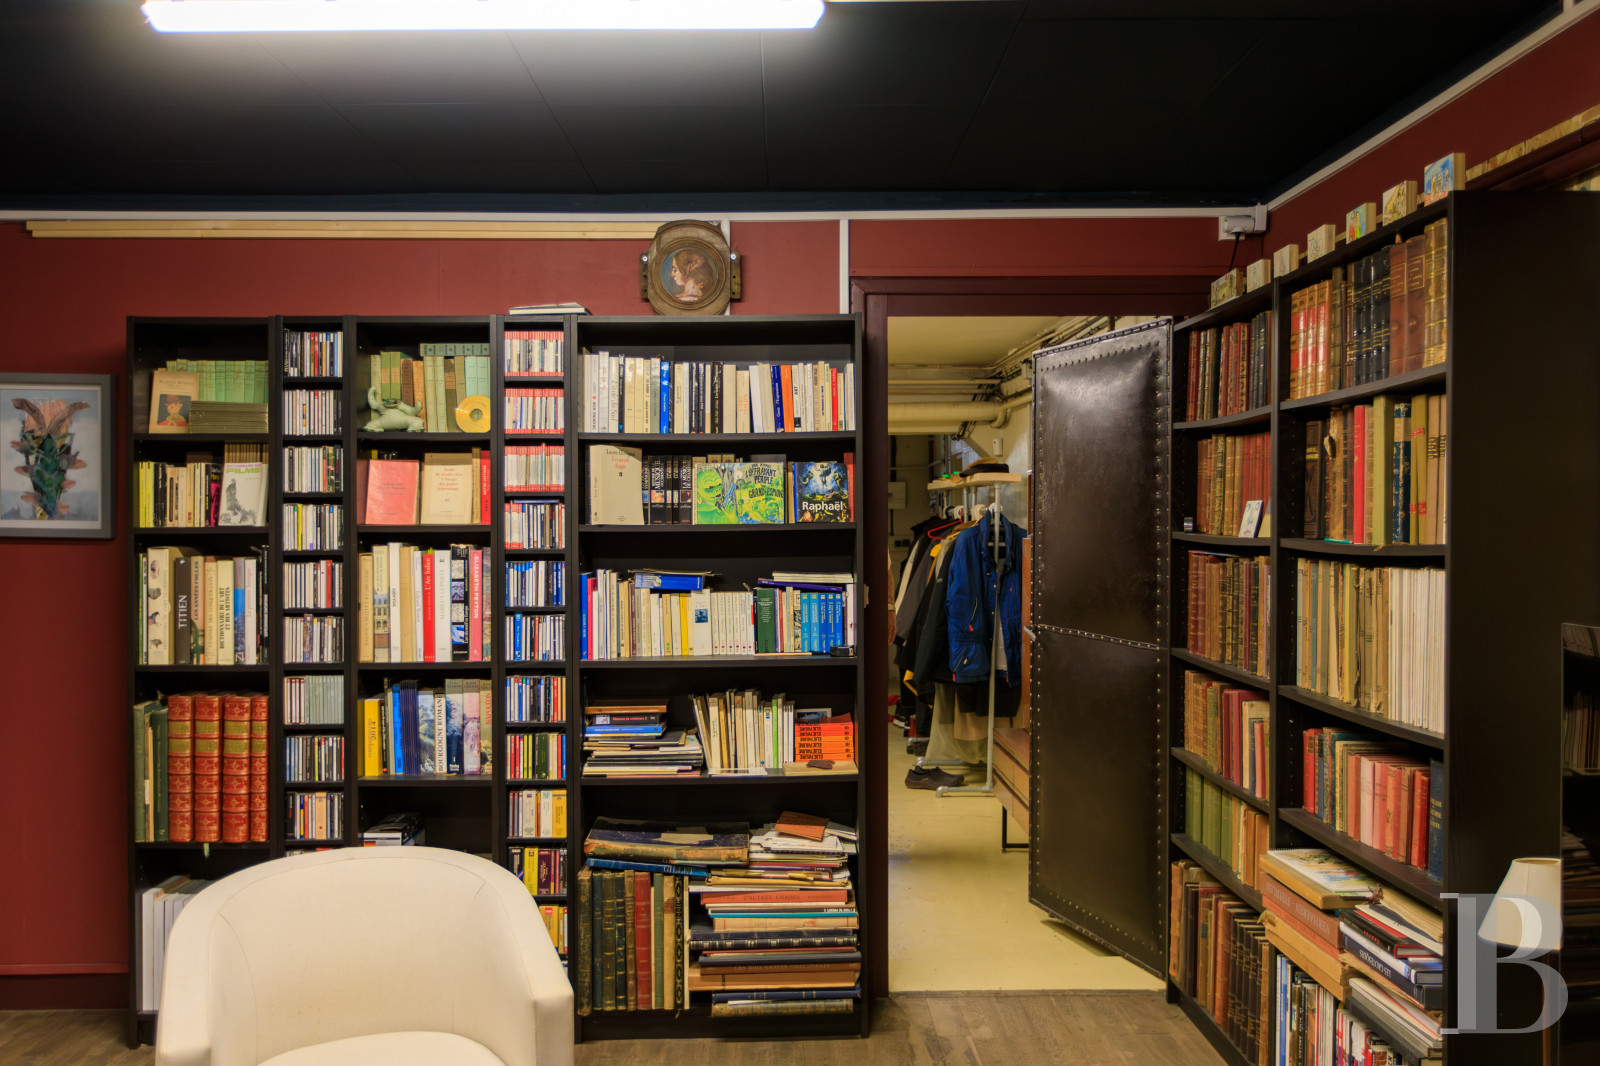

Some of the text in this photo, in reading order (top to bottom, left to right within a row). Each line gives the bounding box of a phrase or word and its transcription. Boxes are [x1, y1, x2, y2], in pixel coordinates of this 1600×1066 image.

[654, 460, 662, 489] MUSIQUE
[802, 501, 844, 513] Raphaël
[178, 594, 188, 629] TITIEN
